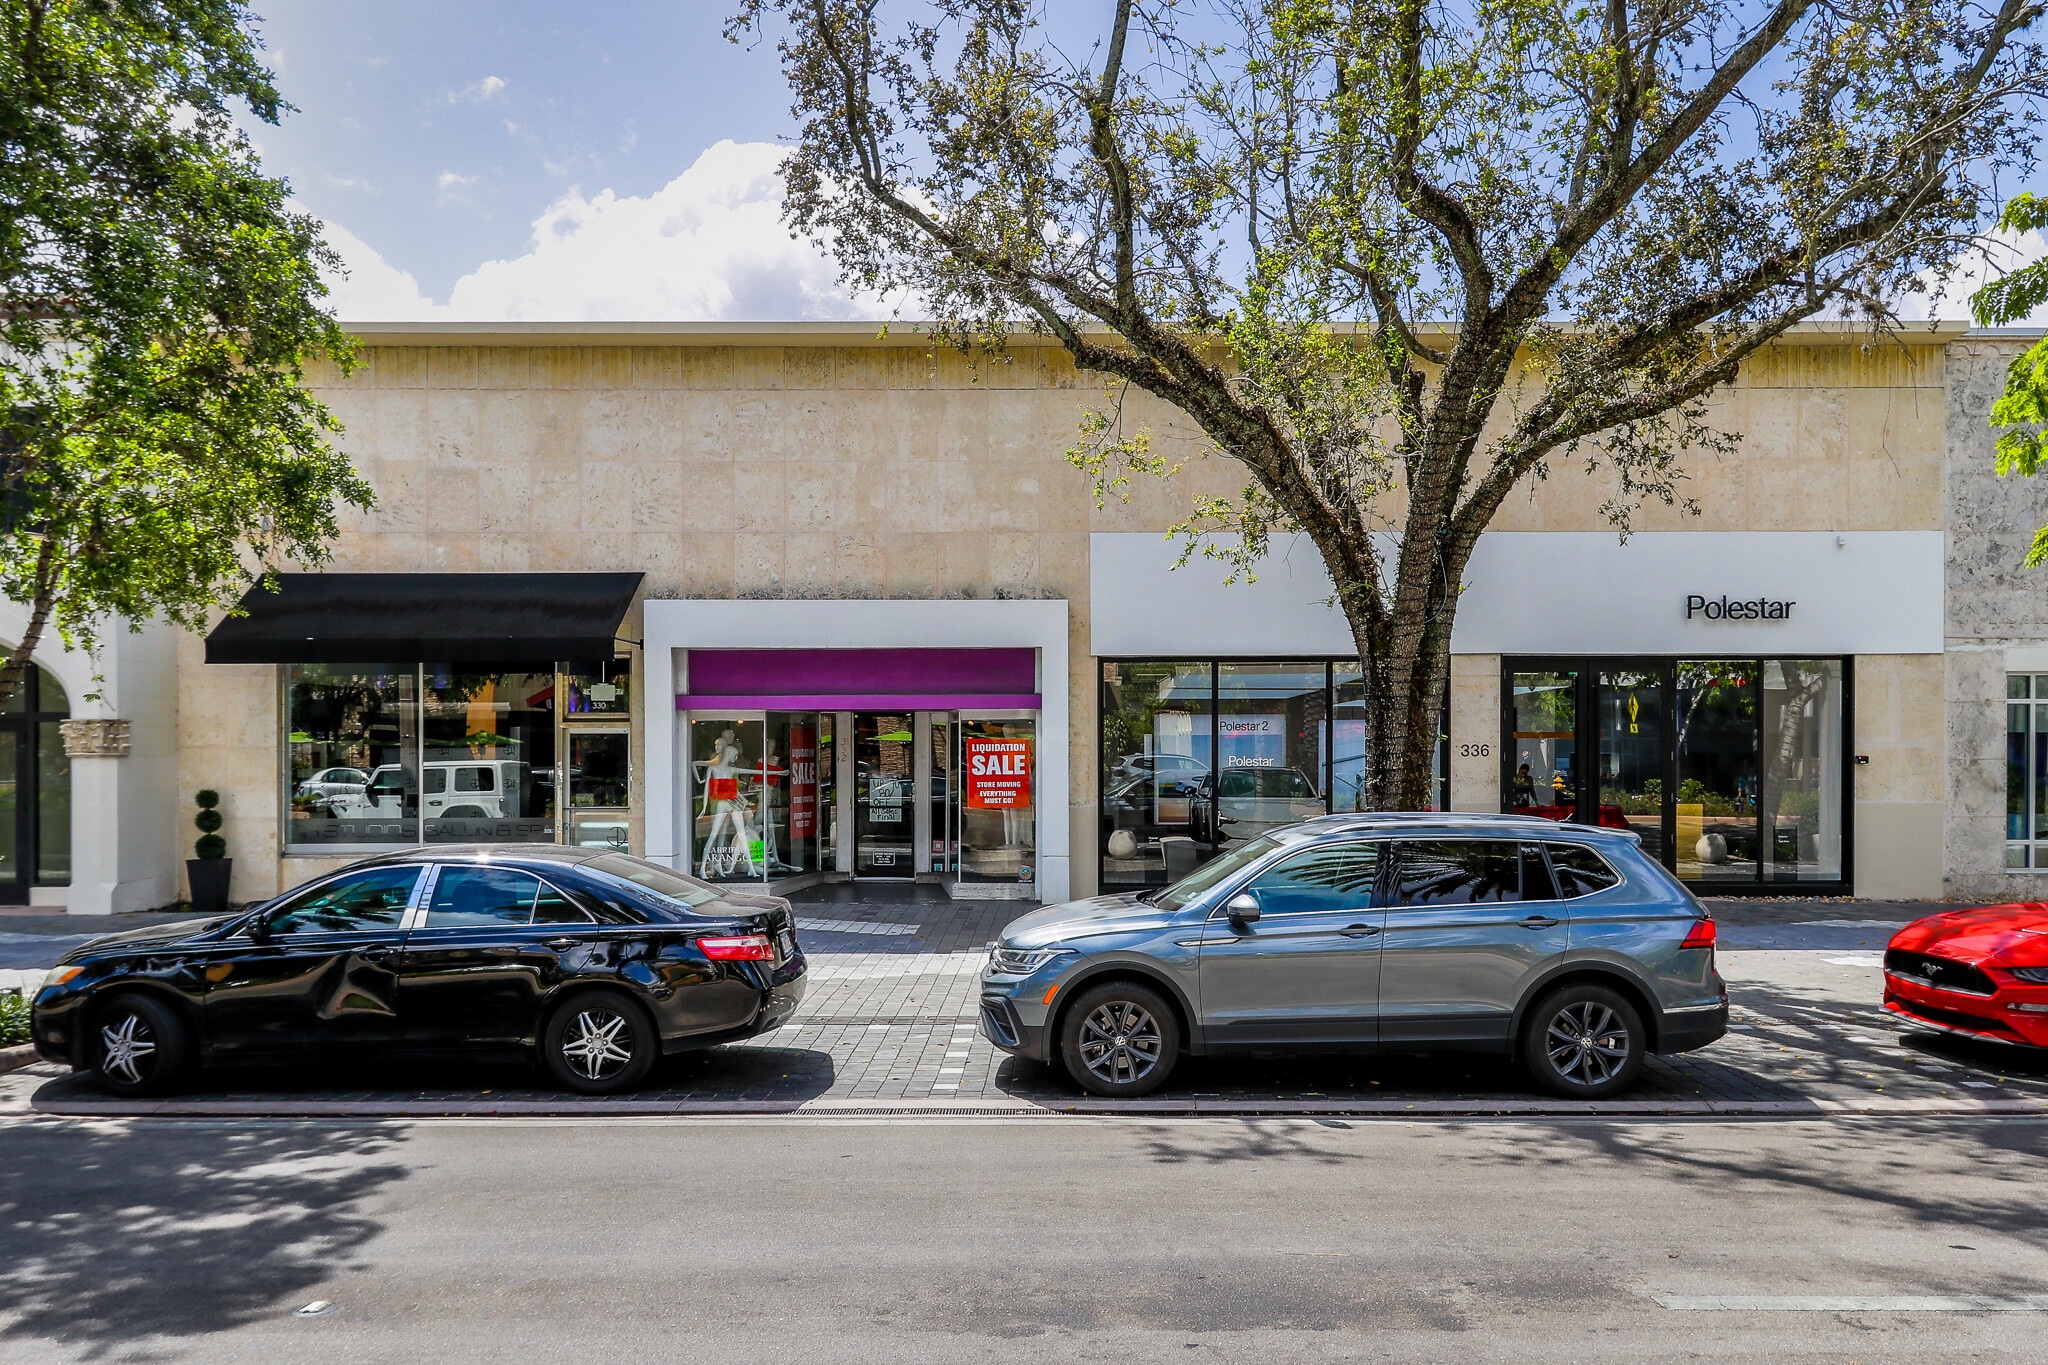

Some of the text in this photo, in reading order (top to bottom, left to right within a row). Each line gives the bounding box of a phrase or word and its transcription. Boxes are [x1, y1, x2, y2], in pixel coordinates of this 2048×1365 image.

[1686, 594, 1796, 620] Polestar
[592, 701, 607, 710] 330
[1219, 720, 1269, 731] Polestar 2
[971, 743, 1026, 754] LIQUIDATION
[1460, 744, 1490, 757] 336
[971, 754, 1026, 776] SALE
[1228, 755, 1274, 767] Polestar
[792, 762, 815, 785] SALE
